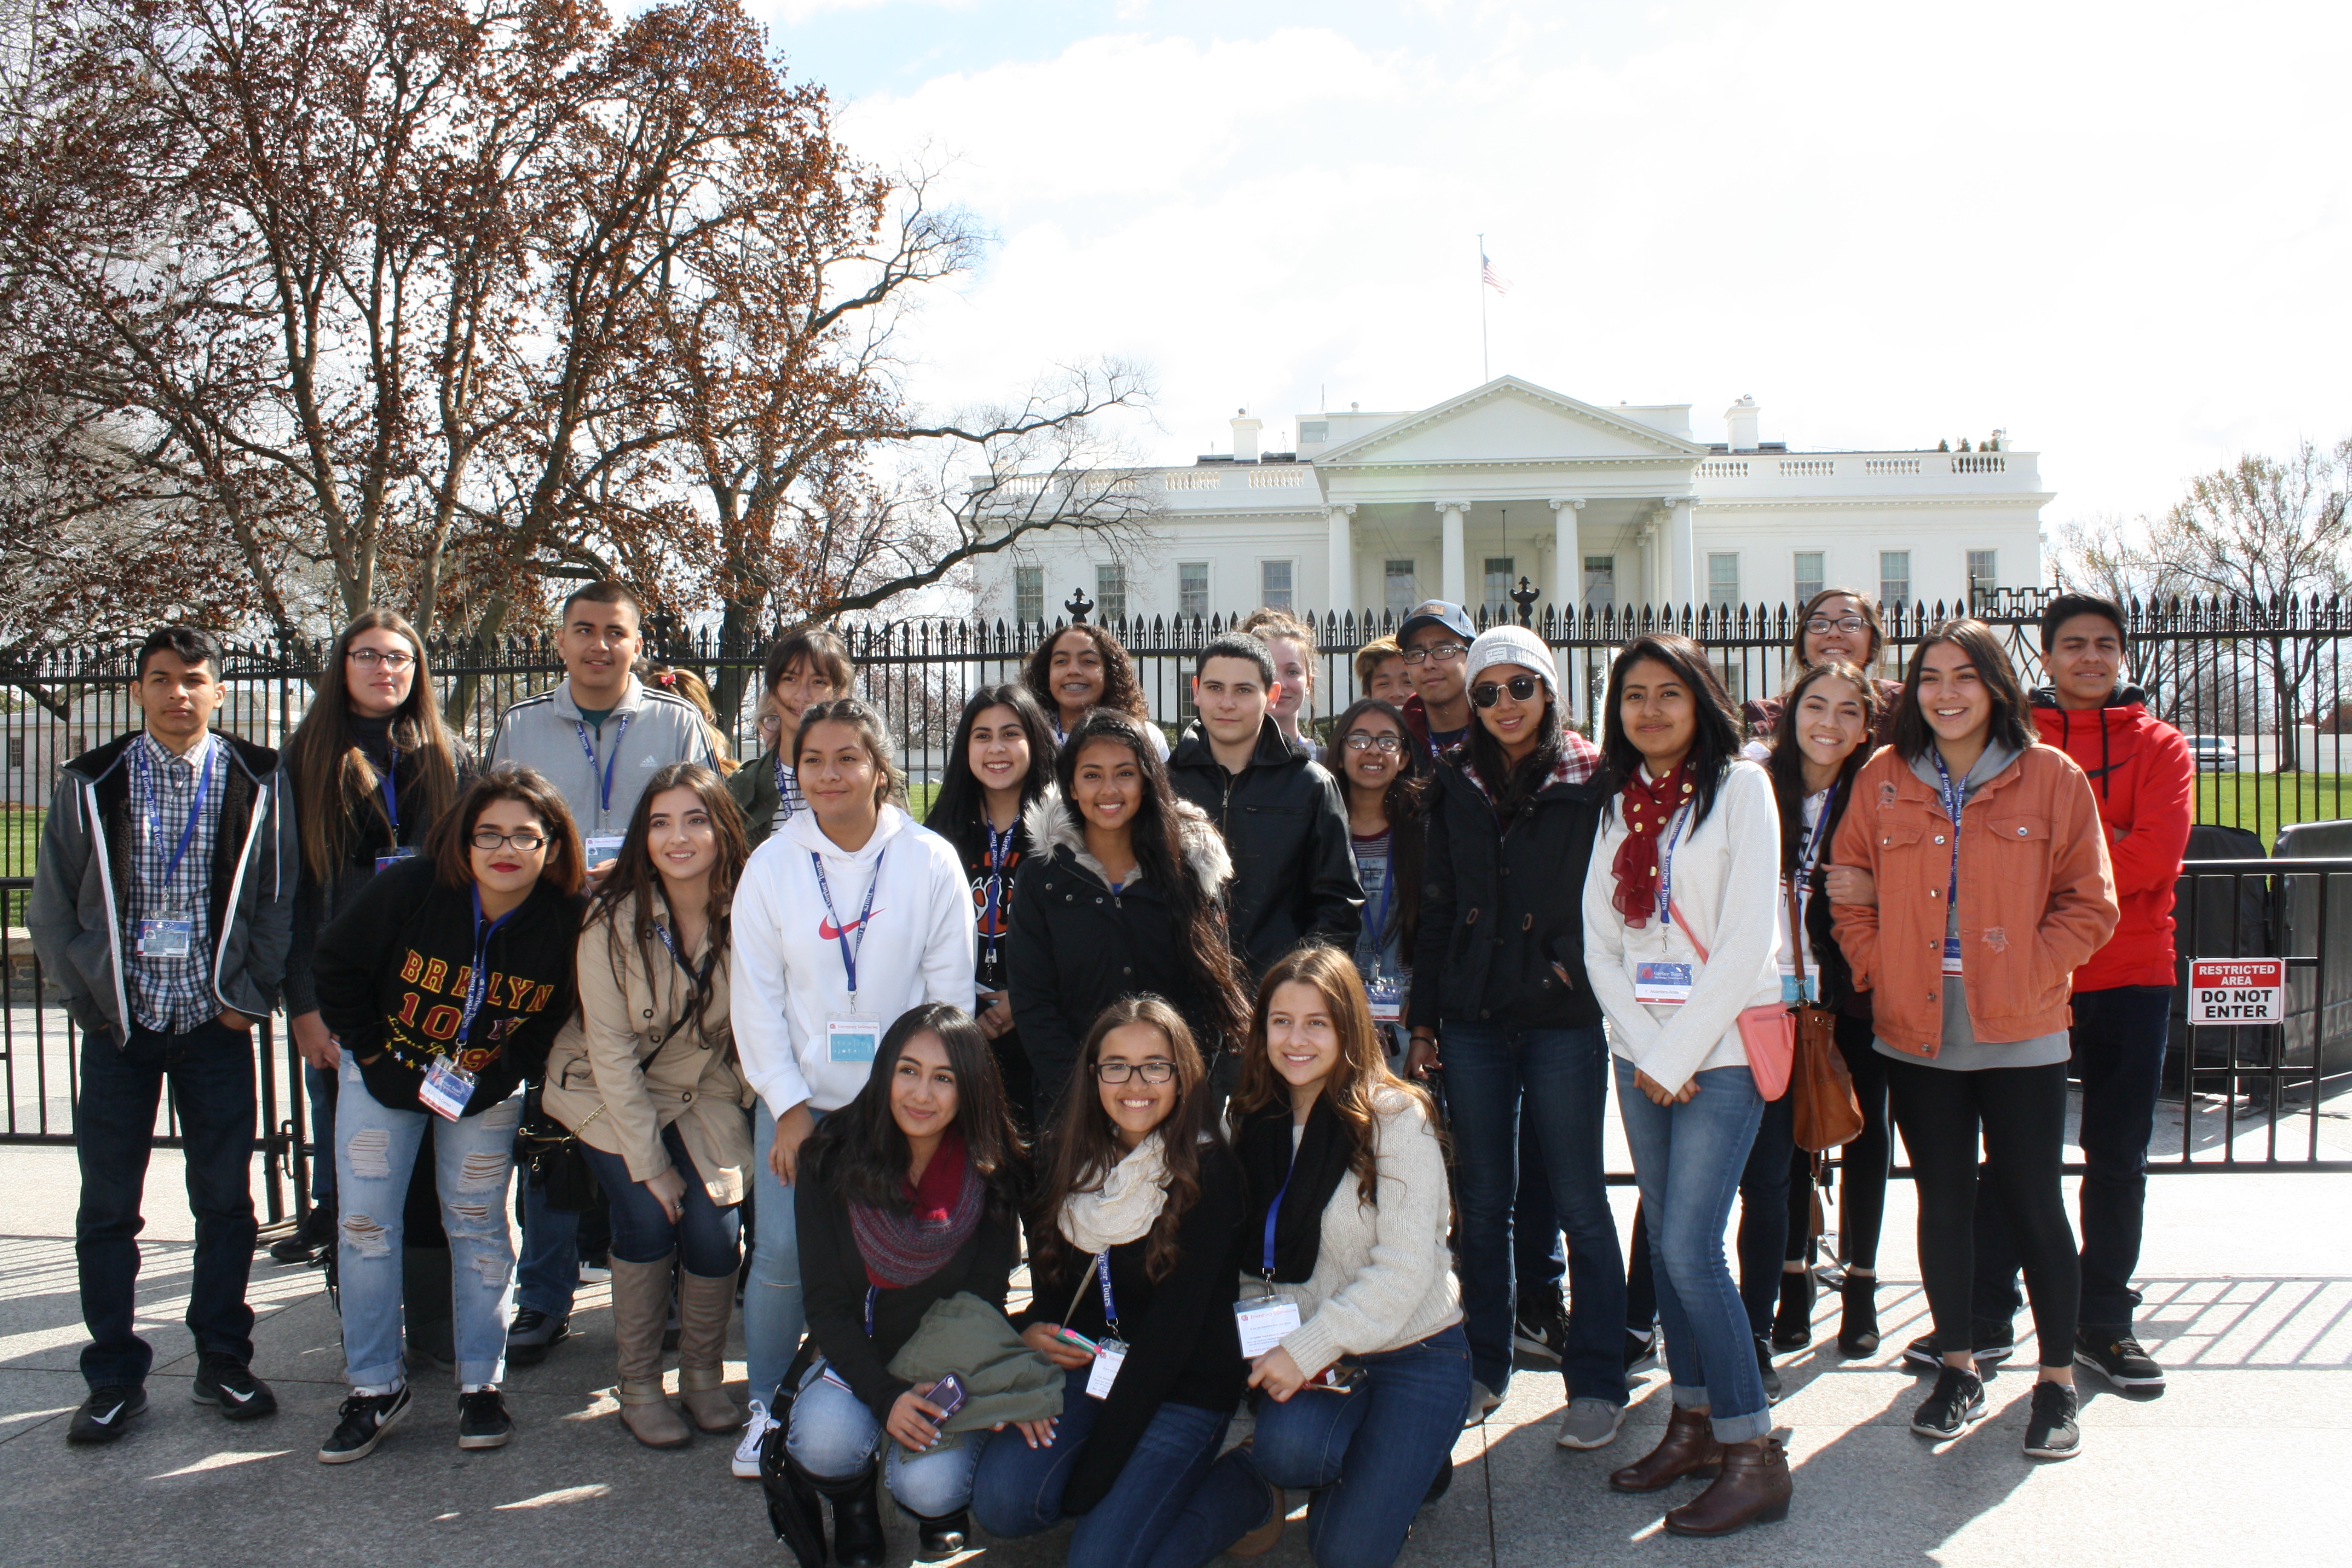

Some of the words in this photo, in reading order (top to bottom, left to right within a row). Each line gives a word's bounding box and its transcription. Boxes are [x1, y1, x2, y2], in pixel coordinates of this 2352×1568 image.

[142, 776, 152, 801] Gerber
[1942, 779, 1952, 803] Gerber
[154, 833, 164, 856] Gerber
[999, 835, 1011, 859] Gerber
[815, 860, 825, 882] Tours
[1662, 858, 1670, 886] Gerber
[822, 881, 832, 907] Gerber
[863, 892, 873, 912] Tours
[1661, 886, 1670, 911] Tours
[2198, 964, 2276, 975] RESTRICTED
[2221, 976, 2253, 985] AREA
[463, 994, 474, 1019] Gerber
[472, 987, 485, 1011] Gerber
[2201, 990, 2227, 1003] DO
[2233, 990, 2273, 1003] NOT
[2205, 1005, 2267, 1018] ENTER
[1102, 1282, 1111, 1307] Tours
